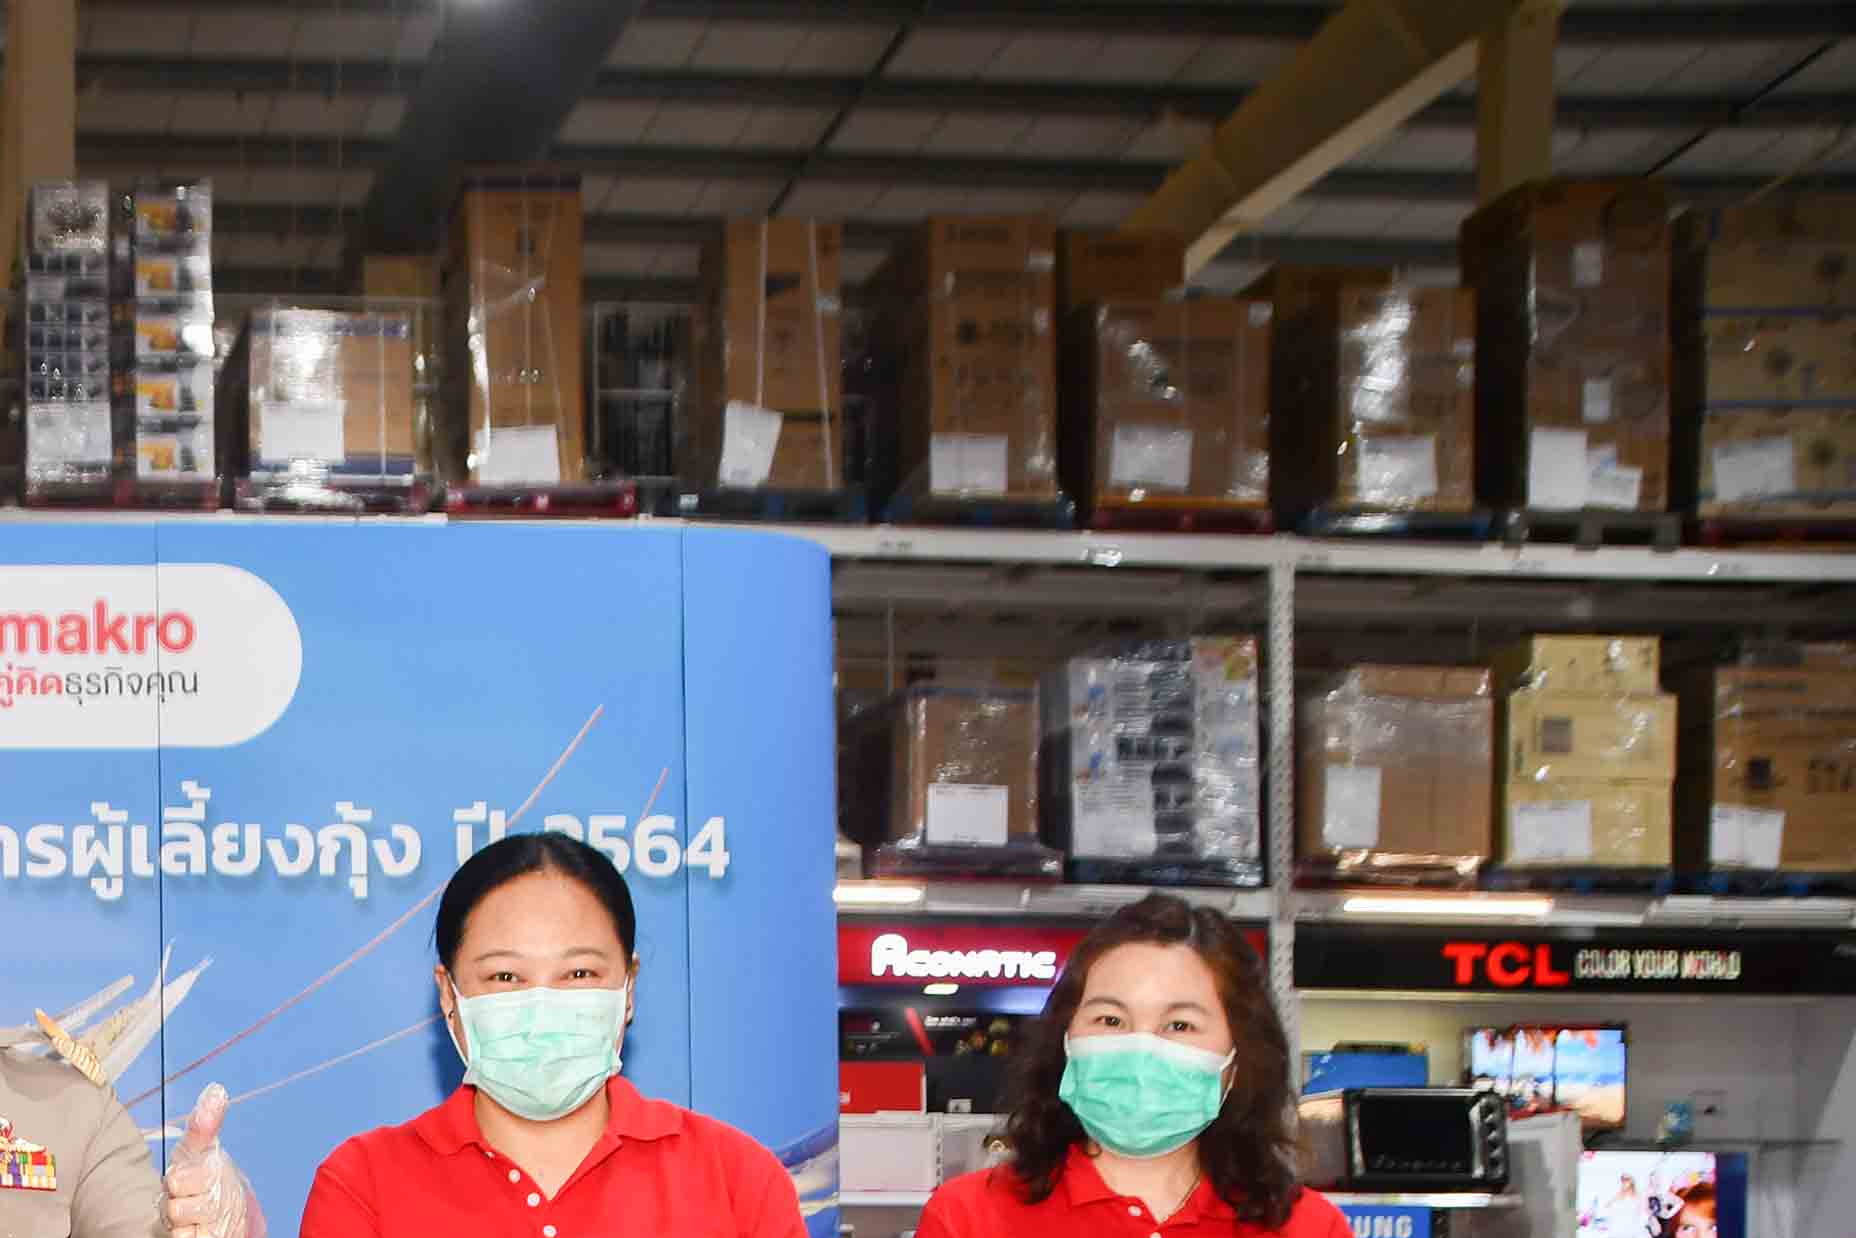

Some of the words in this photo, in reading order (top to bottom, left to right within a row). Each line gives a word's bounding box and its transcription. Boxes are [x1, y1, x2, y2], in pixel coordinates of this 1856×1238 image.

[1442, 942, 1569, 987] TCL
[1575, 949, 1631, 979] COLOR
[1633, 949, 1678, 980] YOUR
[1681, 951, 1741, 980] WORLD
